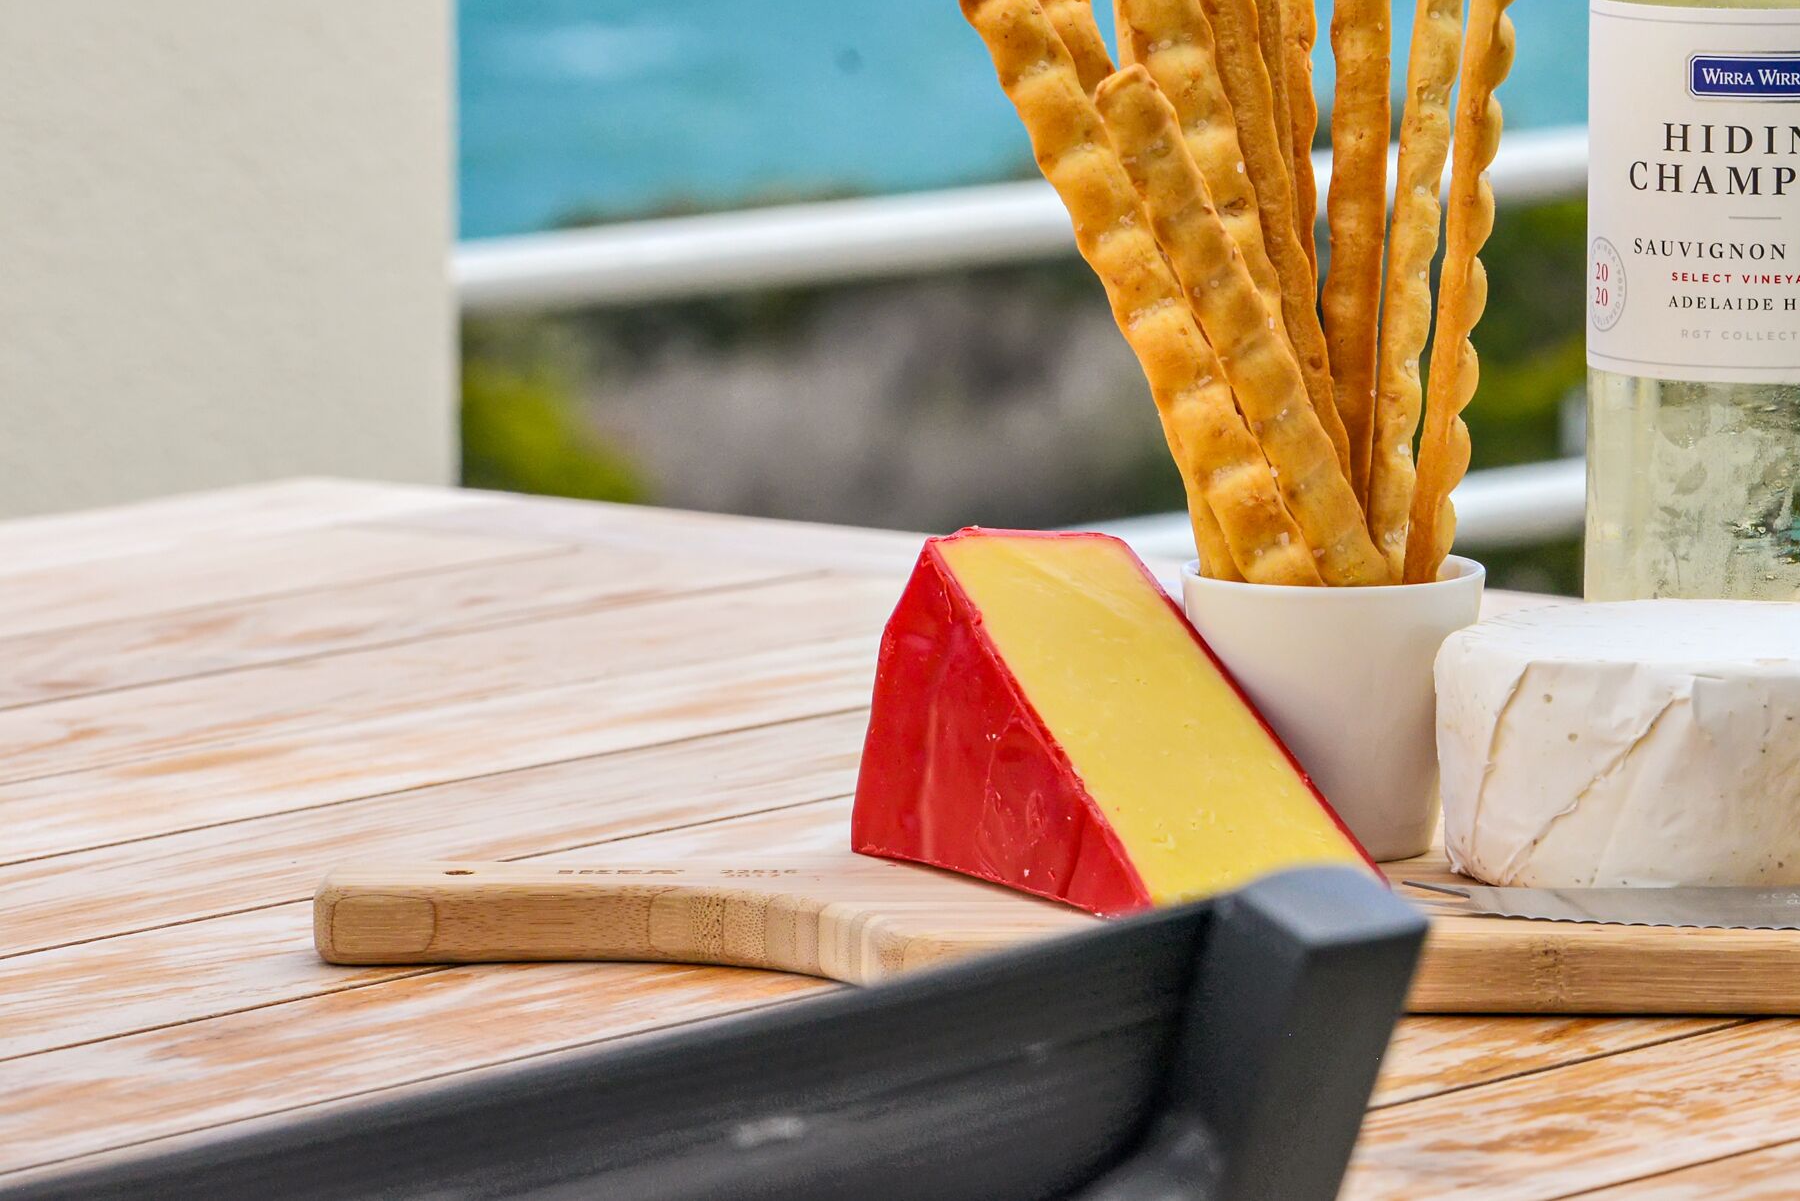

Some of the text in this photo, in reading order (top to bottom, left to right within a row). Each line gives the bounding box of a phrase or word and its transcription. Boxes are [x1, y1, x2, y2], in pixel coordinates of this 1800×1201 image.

[1702, 67, 1755, 86] WIRRA
[1633, 237, 1787, 260] SAUVIGNON
[1595, 262, 1609, 282] 20
[1671, 271, 1732, 284] SELECT
[1595, 286, 1609, 307] 20
[1668, 295, 1774, 311] ADELAIDE
[1681, 329, 1712, 340] RGT
